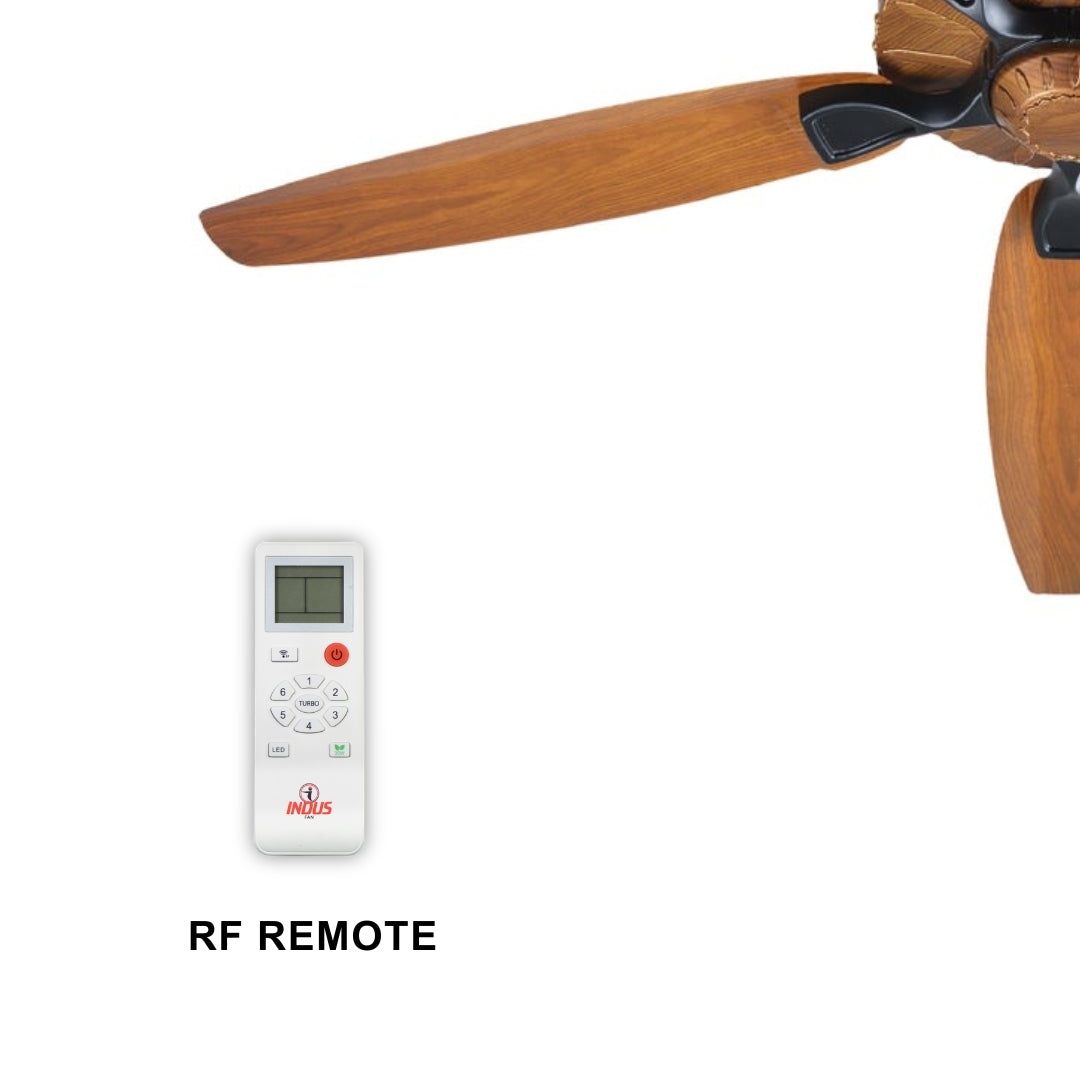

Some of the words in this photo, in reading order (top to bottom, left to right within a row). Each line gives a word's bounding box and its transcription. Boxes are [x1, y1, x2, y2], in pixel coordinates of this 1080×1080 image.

[307, 676, 312, 686] 1
[279, 687, 286, 697] 6
[332, 687, 339, 697] 2
[280, 711, 286, 720] 5
[332, 711, 339, 720] 3
[306, 721, 312, 730] 4
[286, 800, 333, 815] INDUS
